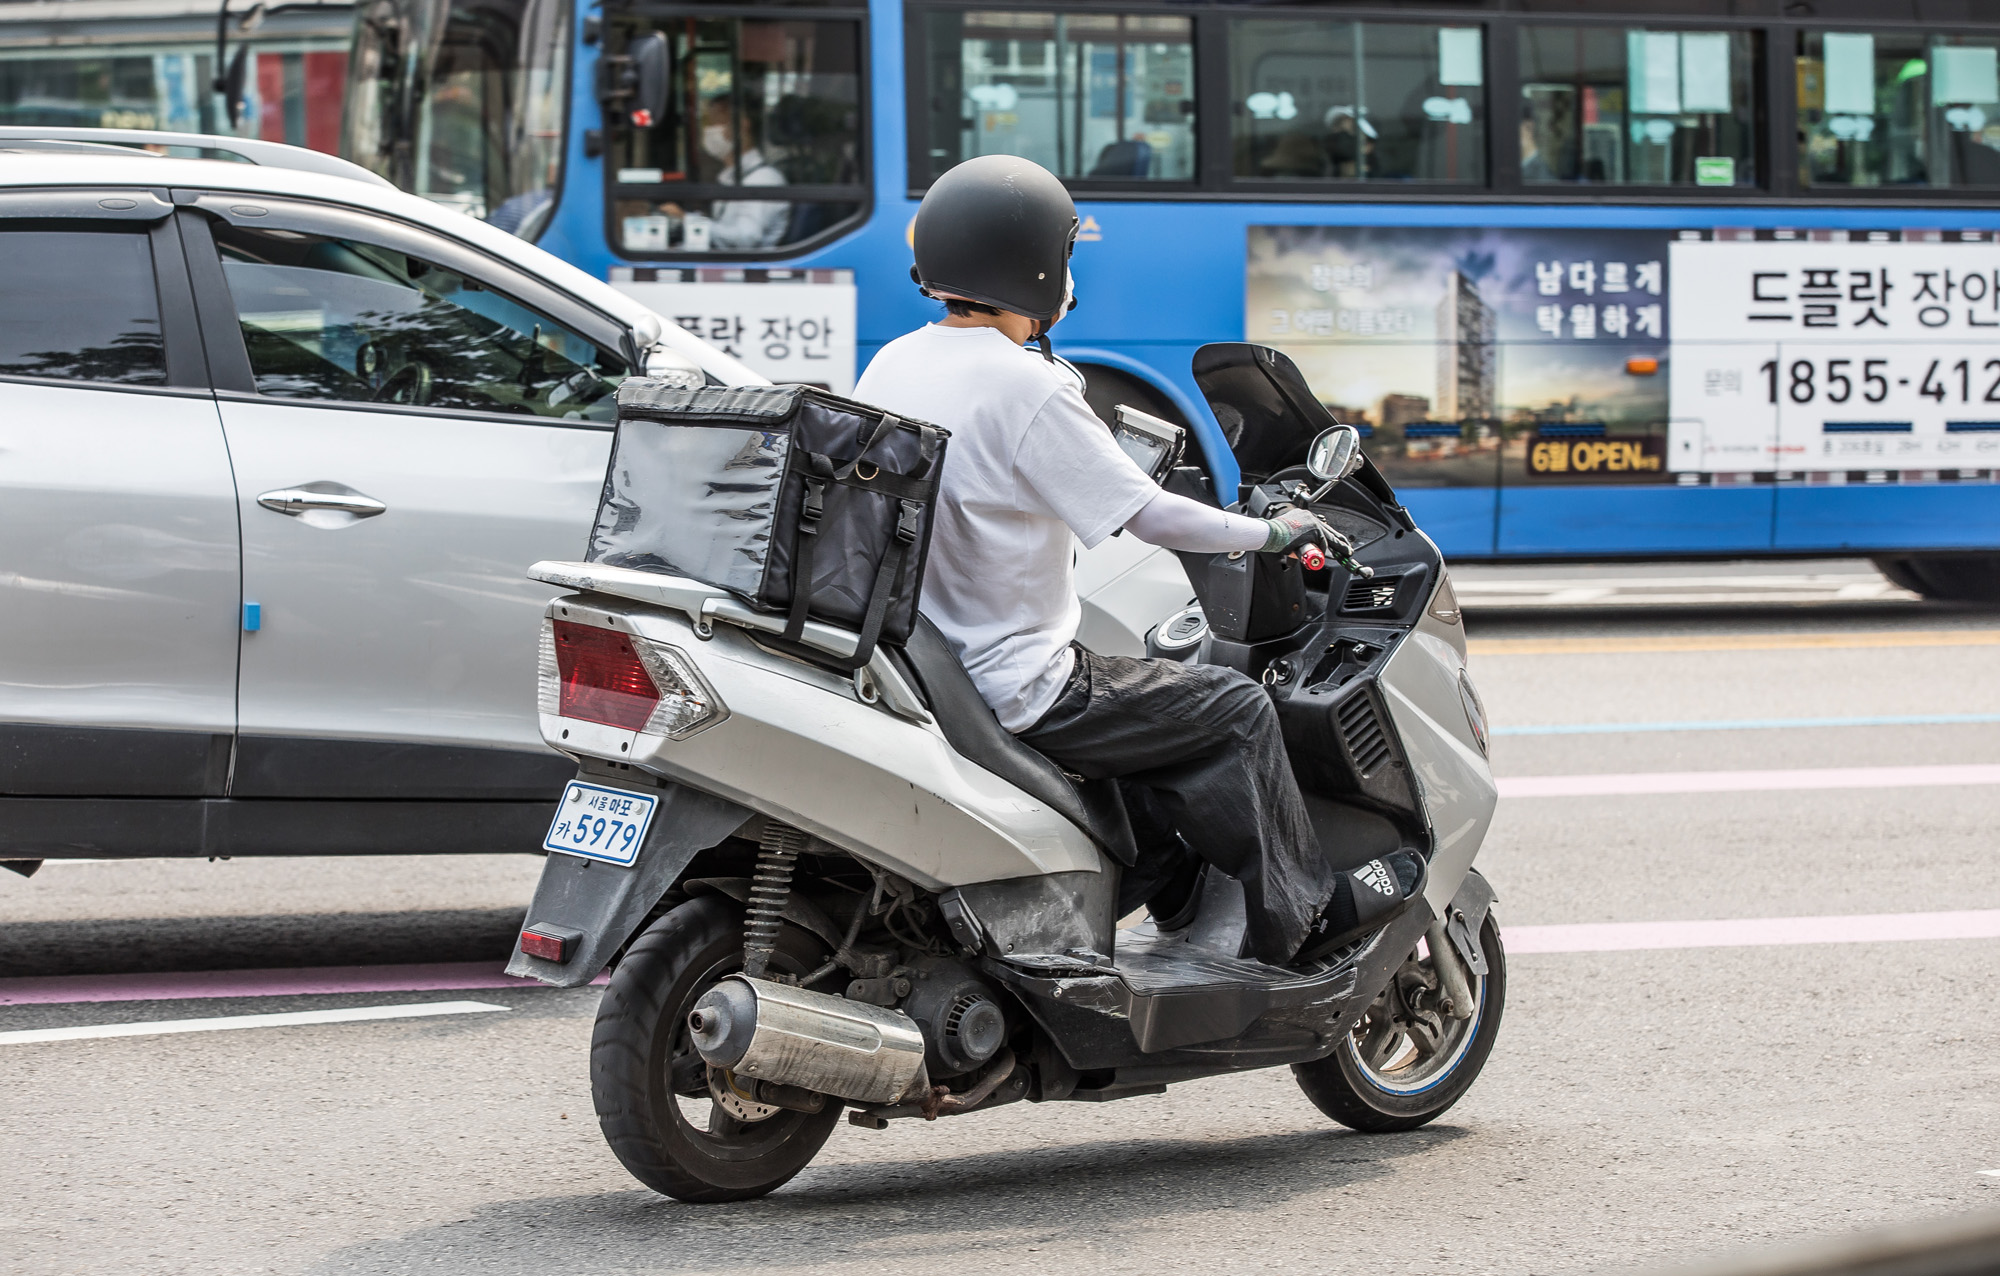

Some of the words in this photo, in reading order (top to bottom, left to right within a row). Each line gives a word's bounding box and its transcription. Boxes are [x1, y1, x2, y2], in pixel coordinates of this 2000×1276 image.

[1535, 260, 1662, 296] 남다르게
[1747, 268, 1894, 328] 드플랏
[1912, 268, 2000, 328] 장안
[760, 315, 834, 360] 장안
[1535, 303, 1662, 339] 탁월하게
[1760, 359, 2000, 404] 1855-412
[1532, 441, 1569, 472] 6월
[1571, 441, 1643, 471] OPEN
[588, 796, 608, 811] 서울
[608, 799, 634, 816] 마포
[555, 820, 571, 839] 카
[573, 814, 637, 852] 5979
[1369, 859, 1395, 896] adidas
